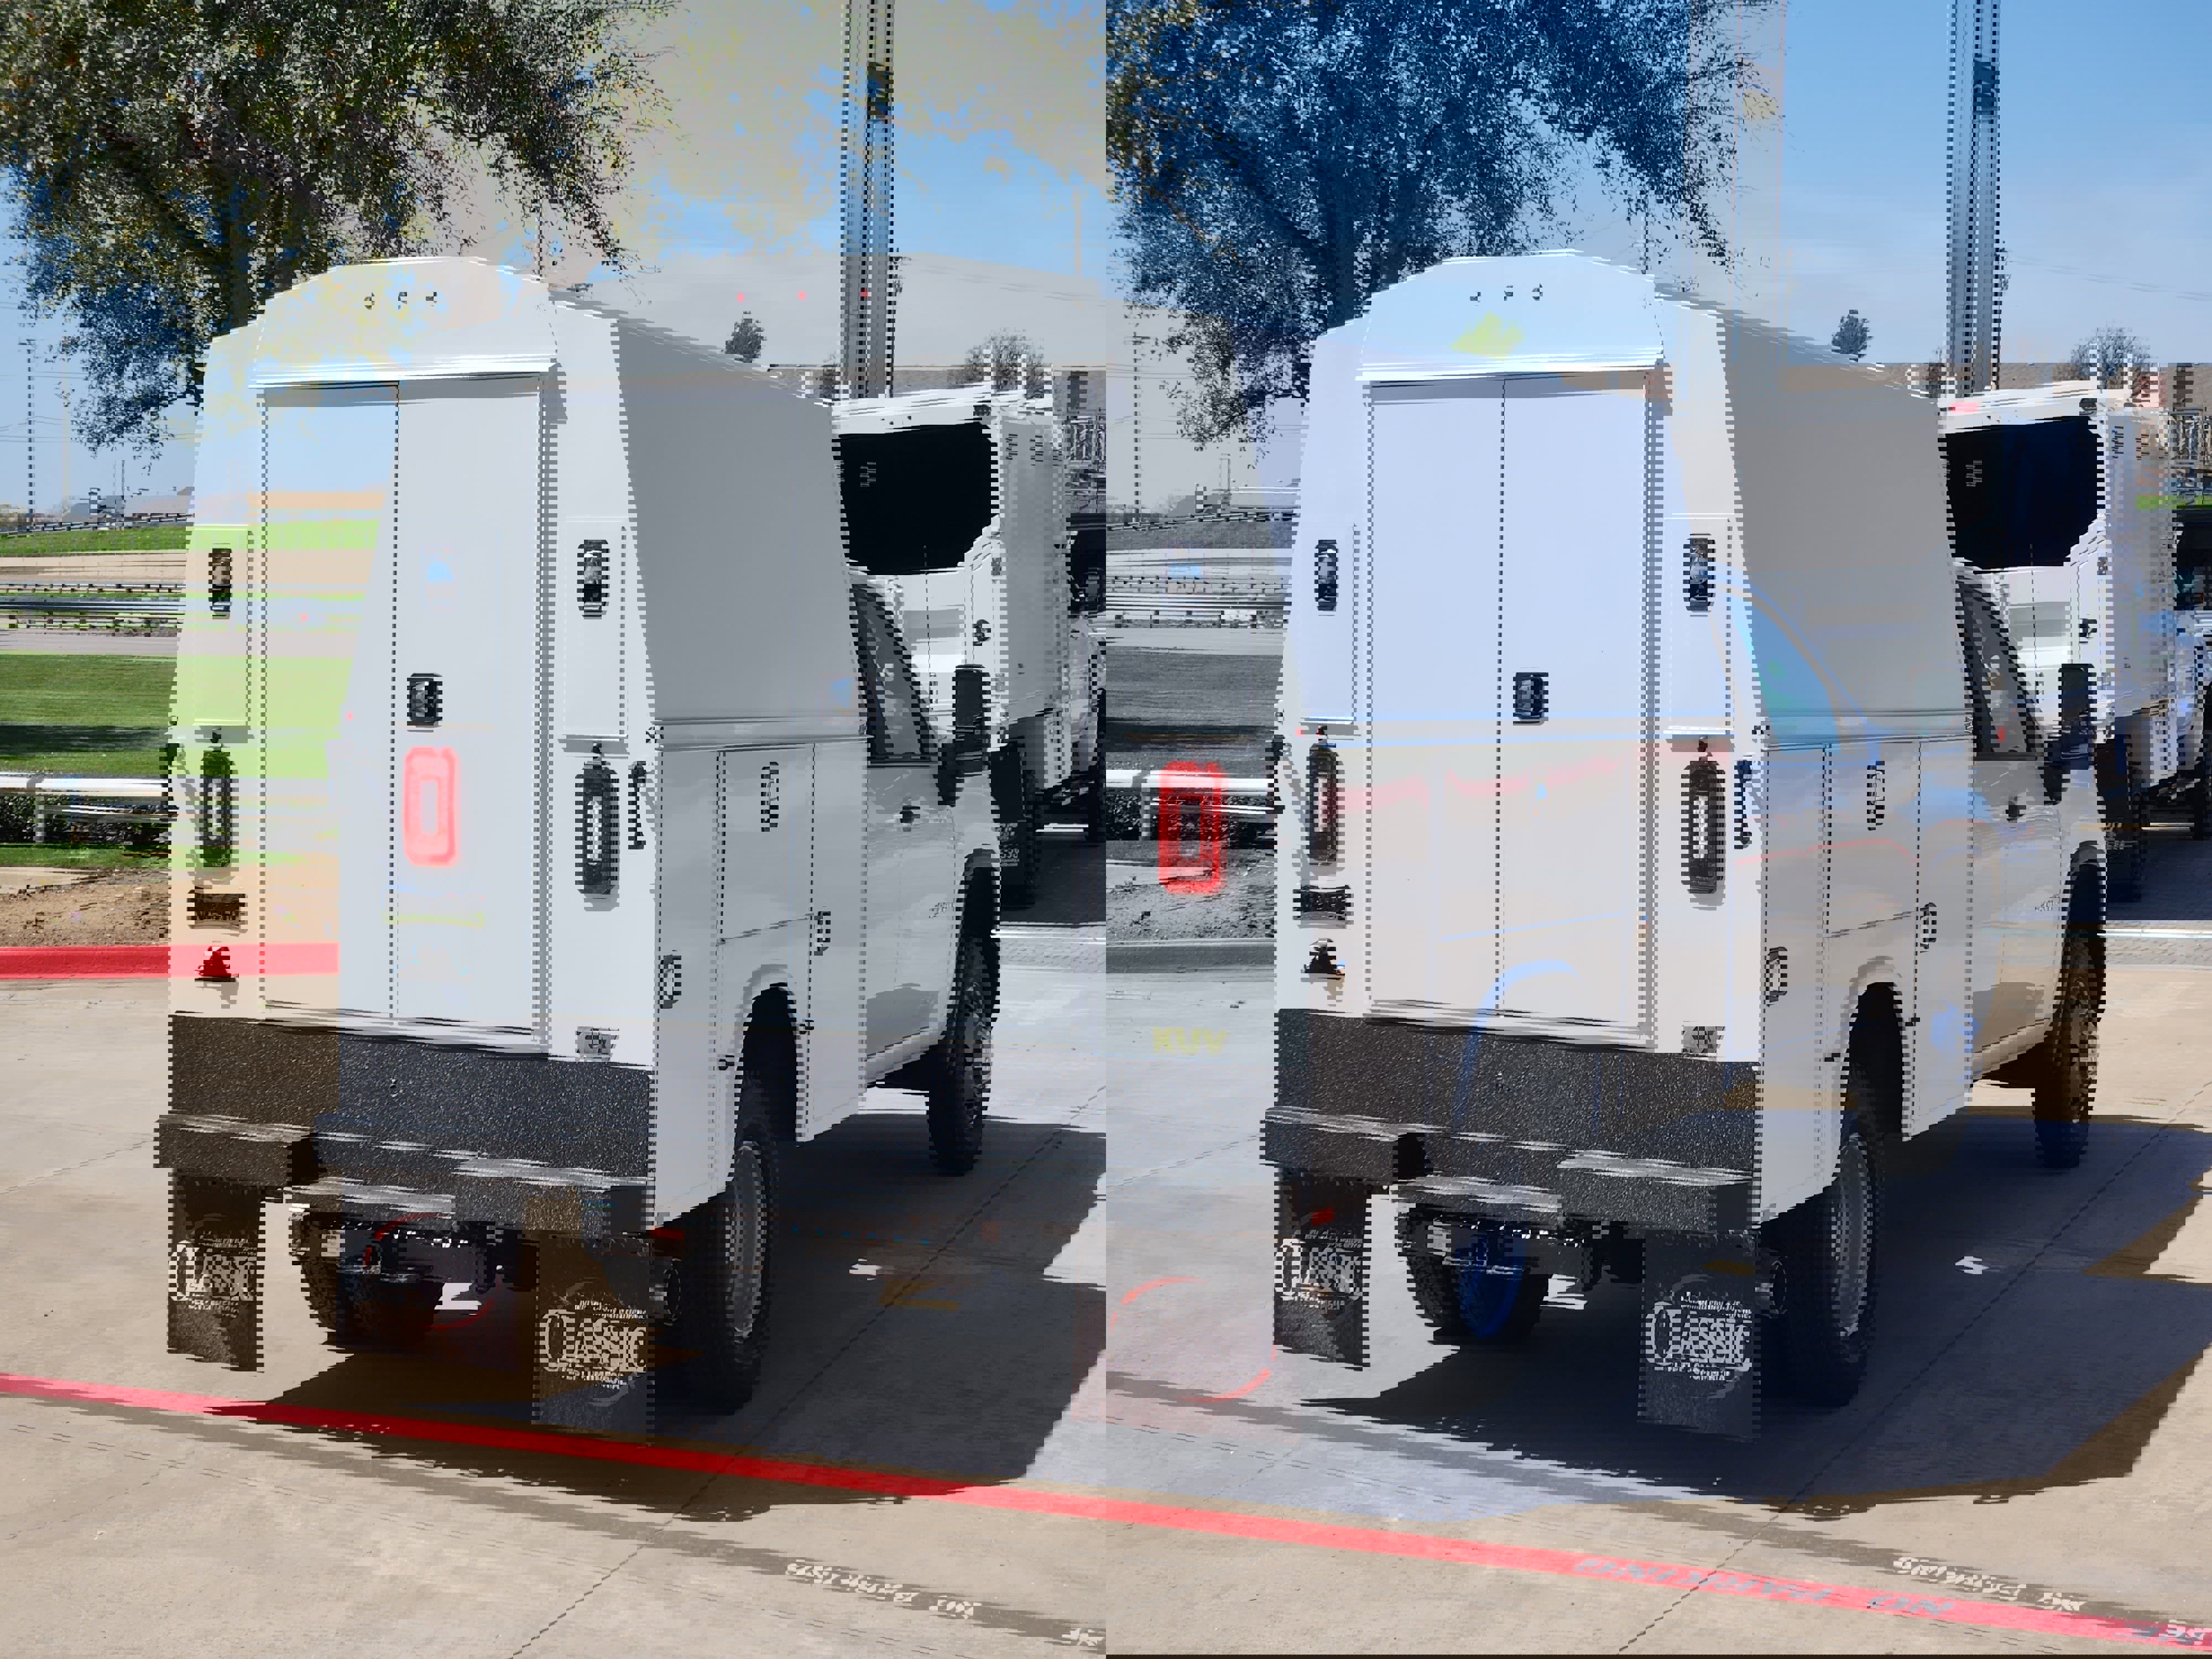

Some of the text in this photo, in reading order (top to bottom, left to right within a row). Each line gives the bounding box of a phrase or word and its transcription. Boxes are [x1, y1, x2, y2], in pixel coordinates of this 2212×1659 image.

[1152, 1025, 1230, 1057] KUV
[444, 1236, 462, 1249] enjoy
[463, 1237, 476, 1248] the
[343, 1239, 512, 1302] CLASSIC
[377, 1292, 476, 1314] FLEET COMMERCIAL
[1204, 1302, 1228, 1317] enjoy
[1229, 1303, 1244, 1315] the
[1084, 1305, 1291, 1374] CLASSIC
[1127, 1362, 1246, 1386] FLEET COMMERCIAL
[1572, 1558, 1956, 1616] NO PARKING
[2112, 1623, 2212, 1646] NE
